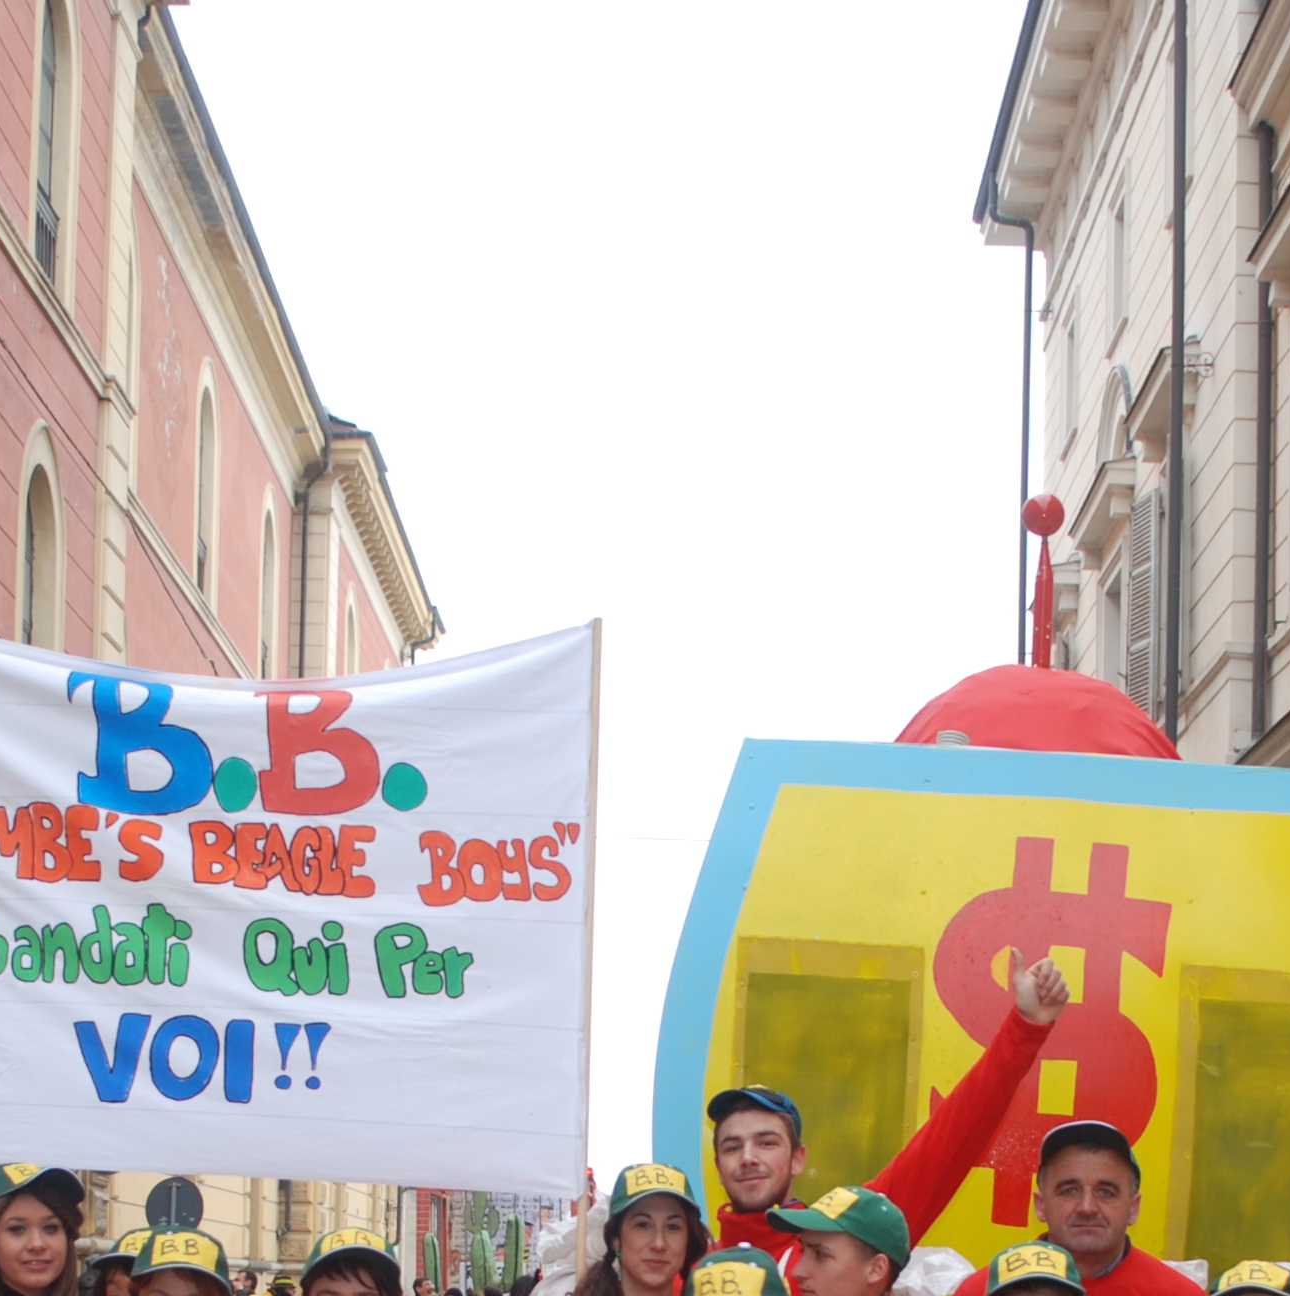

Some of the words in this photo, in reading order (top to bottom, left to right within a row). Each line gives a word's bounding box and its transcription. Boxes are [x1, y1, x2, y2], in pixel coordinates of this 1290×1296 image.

[67, 671, 429, 816] B.B.
[188, 820, 377, 899] BEAGLE
[242, 916, 351, 997] Qui
[373, 921, 475, 999] Per
[698, 1268, 743, 1296] B.B.
